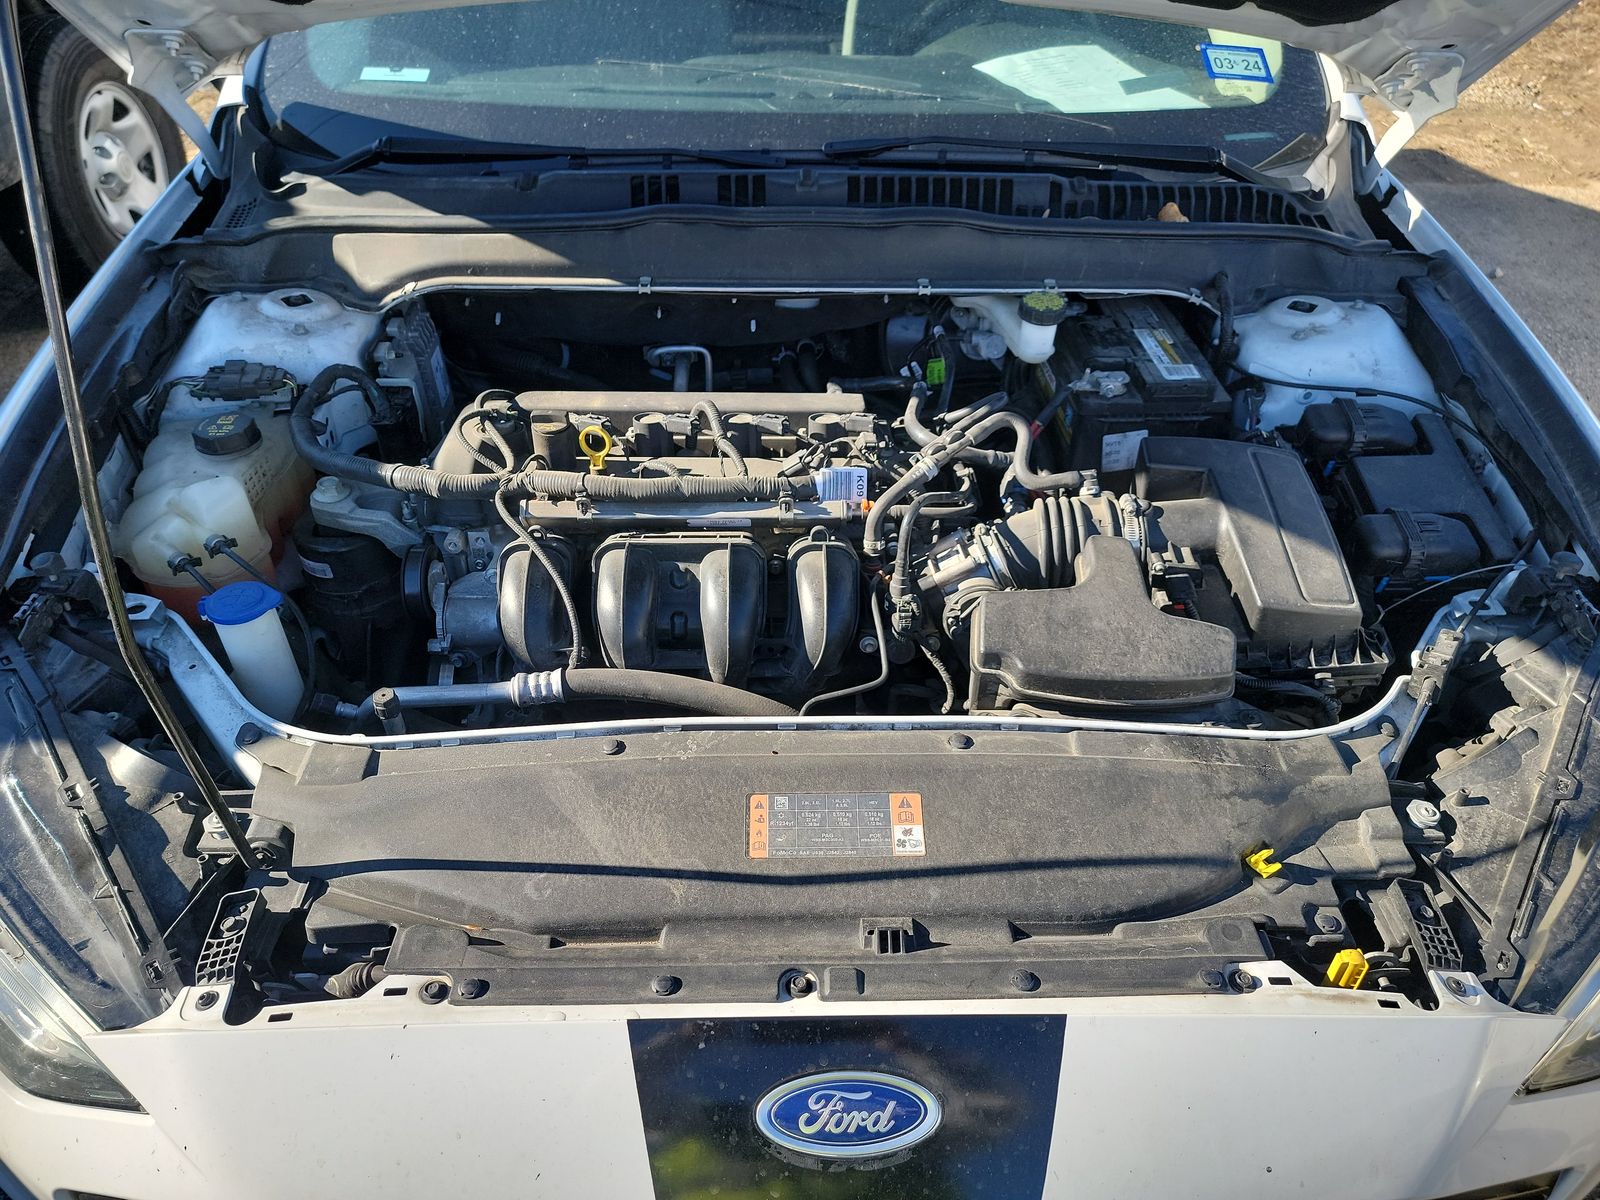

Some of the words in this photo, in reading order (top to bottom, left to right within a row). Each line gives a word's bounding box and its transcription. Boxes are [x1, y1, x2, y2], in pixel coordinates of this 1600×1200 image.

[1213, 56, 1234, 70] 03
[1241, 59, 1262, 72] 24
[856, 475, 865, 497] K09
[798, 1089, 897, 1134] Ford
